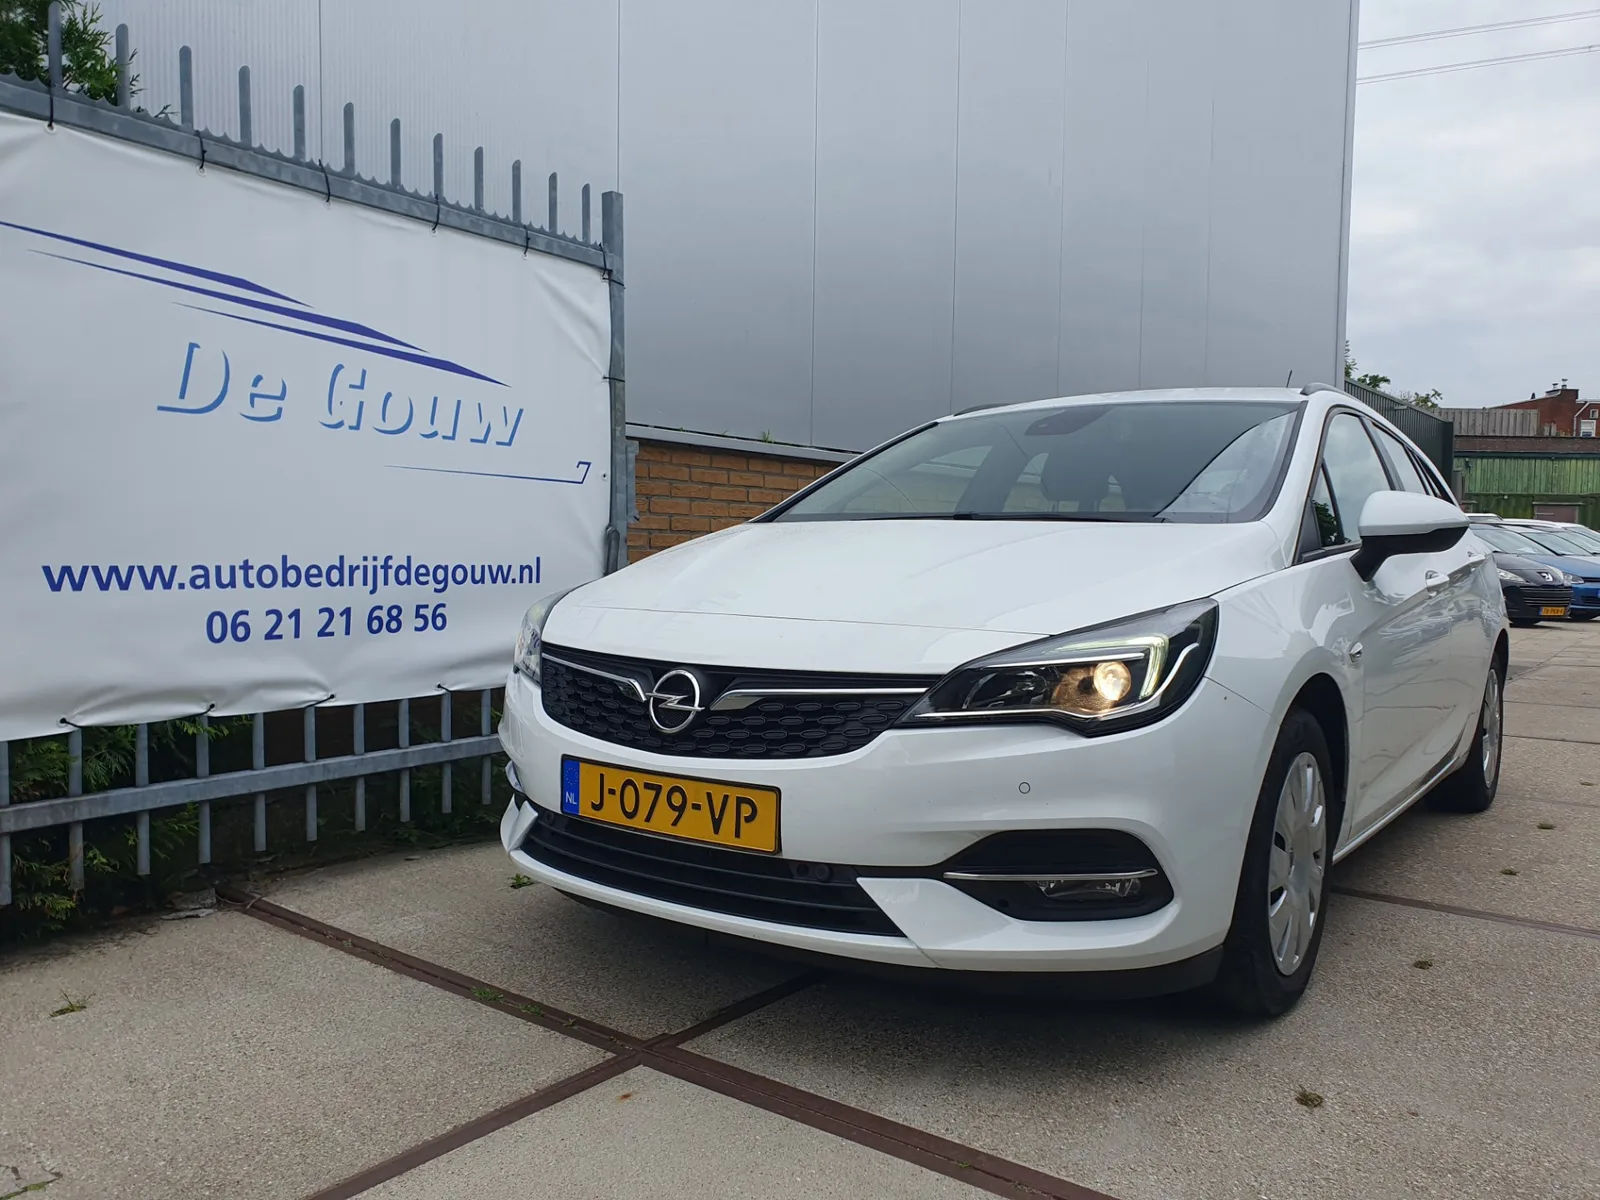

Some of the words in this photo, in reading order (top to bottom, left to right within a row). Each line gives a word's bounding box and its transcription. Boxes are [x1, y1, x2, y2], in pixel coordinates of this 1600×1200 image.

[157, 342, 287, 423] De
[318, 363, 524, 447] Gouw
[41, 555, 541, 595] www.autobedrijfdegouw.nl
[206, 609, 251, 644] 06
[264, 608, 301, 641] 21
[316, 606, 352, 638] 21
[367, 604, 403, 635] 68
[413, 602, 448, 632] 56
[565, 791, 578, 805] NL
[590, 772, 758, 839] J-079-VP
